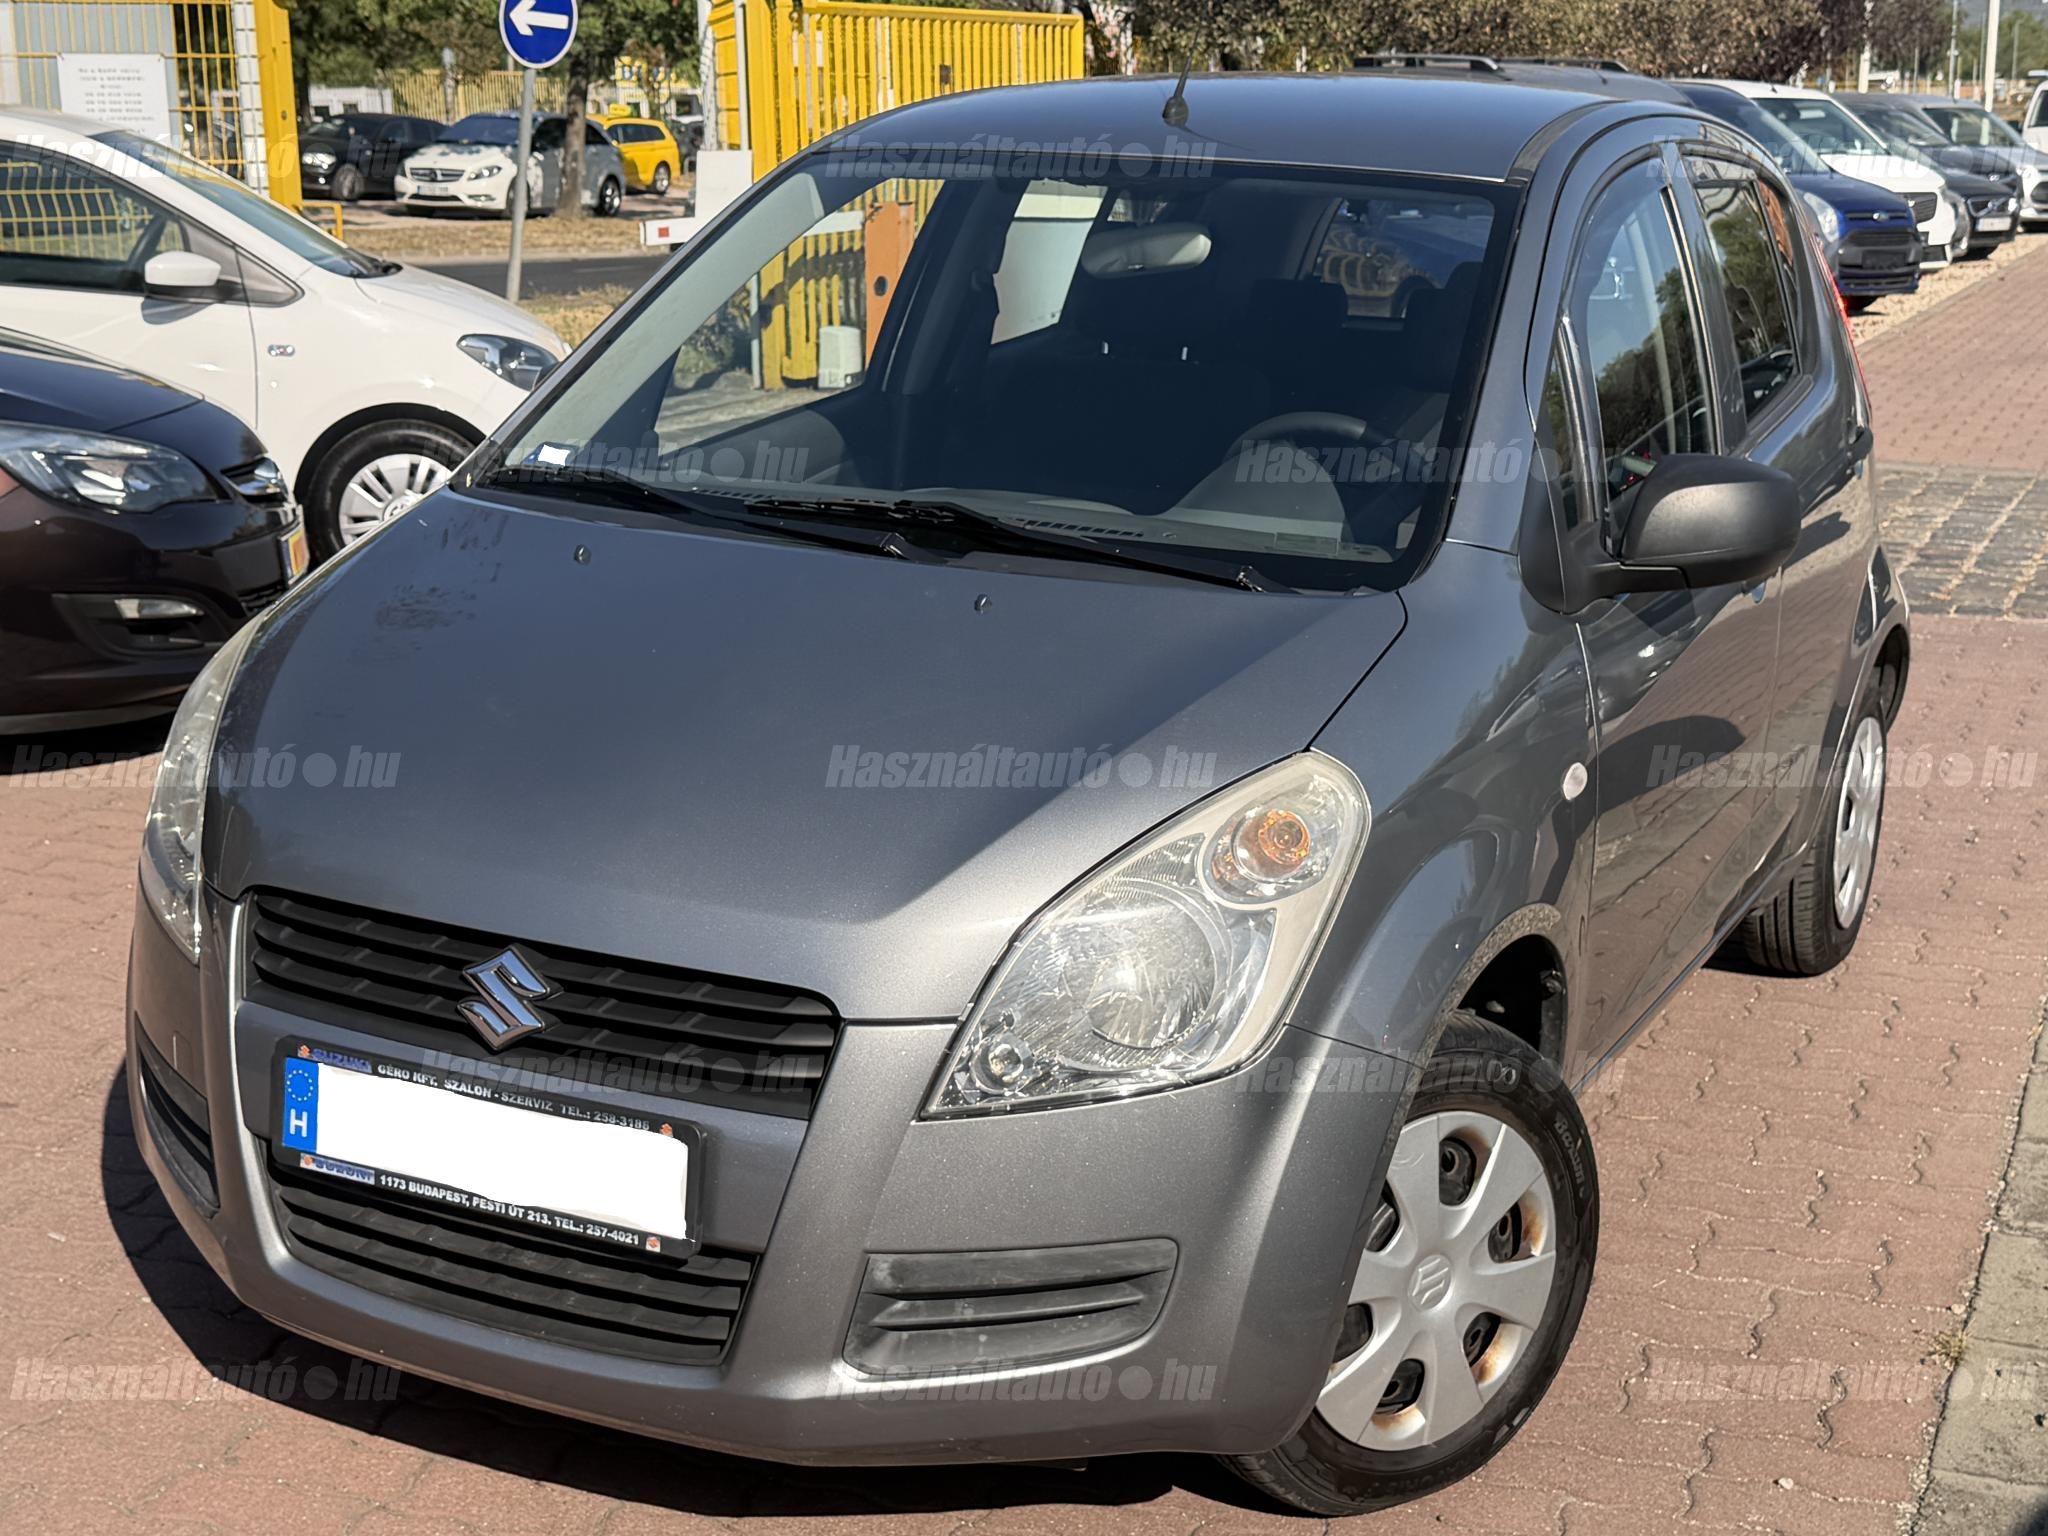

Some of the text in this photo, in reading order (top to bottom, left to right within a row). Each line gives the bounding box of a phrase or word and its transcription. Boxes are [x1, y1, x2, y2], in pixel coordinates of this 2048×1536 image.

[443, 1078, 492, 1099] SZALON
[501, 1091, 554, 1111] SZERVIZ
[288, 1107, 309, 1138] H
[379, 1174, 406, 1191] 1173
[472, 1195, 506, 1214] PESTI
[527, 1209, 552, 1226] 213.
[554, 1216, 584, 1233] TEL.:
[586, 1223, 639, 1246] 257-4021
